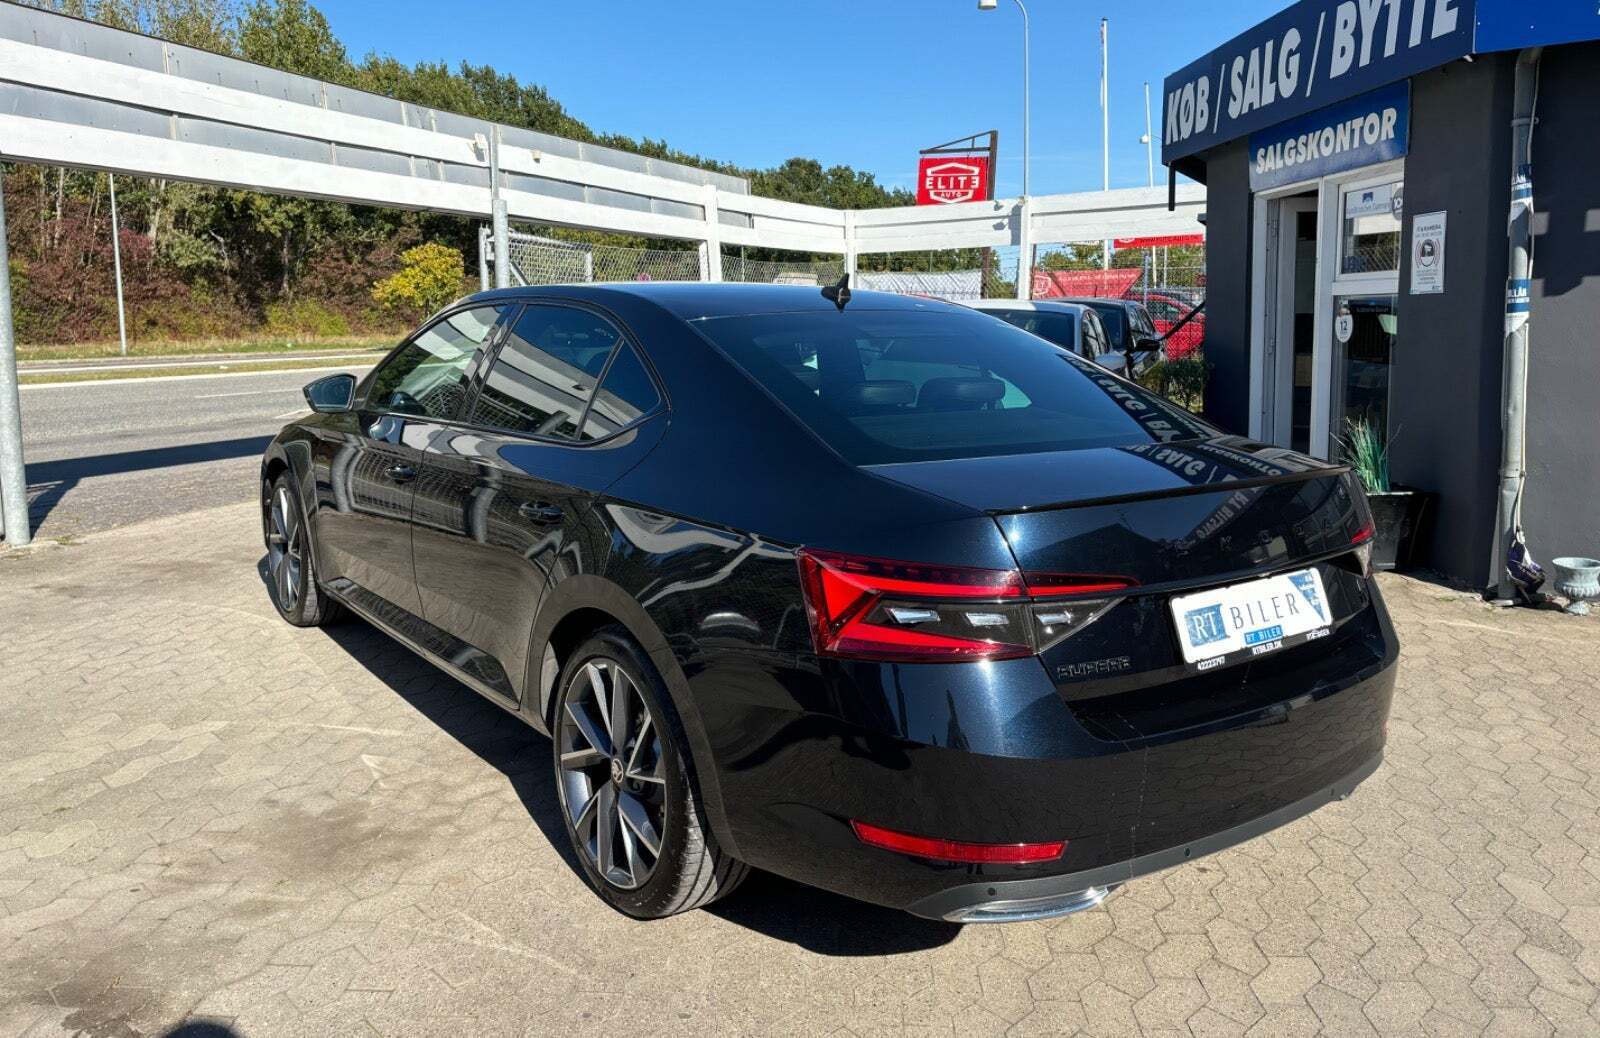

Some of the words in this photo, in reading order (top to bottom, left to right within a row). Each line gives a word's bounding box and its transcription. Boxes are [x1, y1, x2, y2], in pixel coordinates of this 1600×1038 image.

[1166, 75, 1210, 146] KØB
[1228, 27, 1302, 119] SALG
[1255, 107, 1397, 174] SALGSKONTOR
[925, 176, 980, 190] ELITE
[1192, 611, 1219, 640] RT
[1229, 592, 1300, 630] BILER
[1258, 626, 1282, 640] BILER
